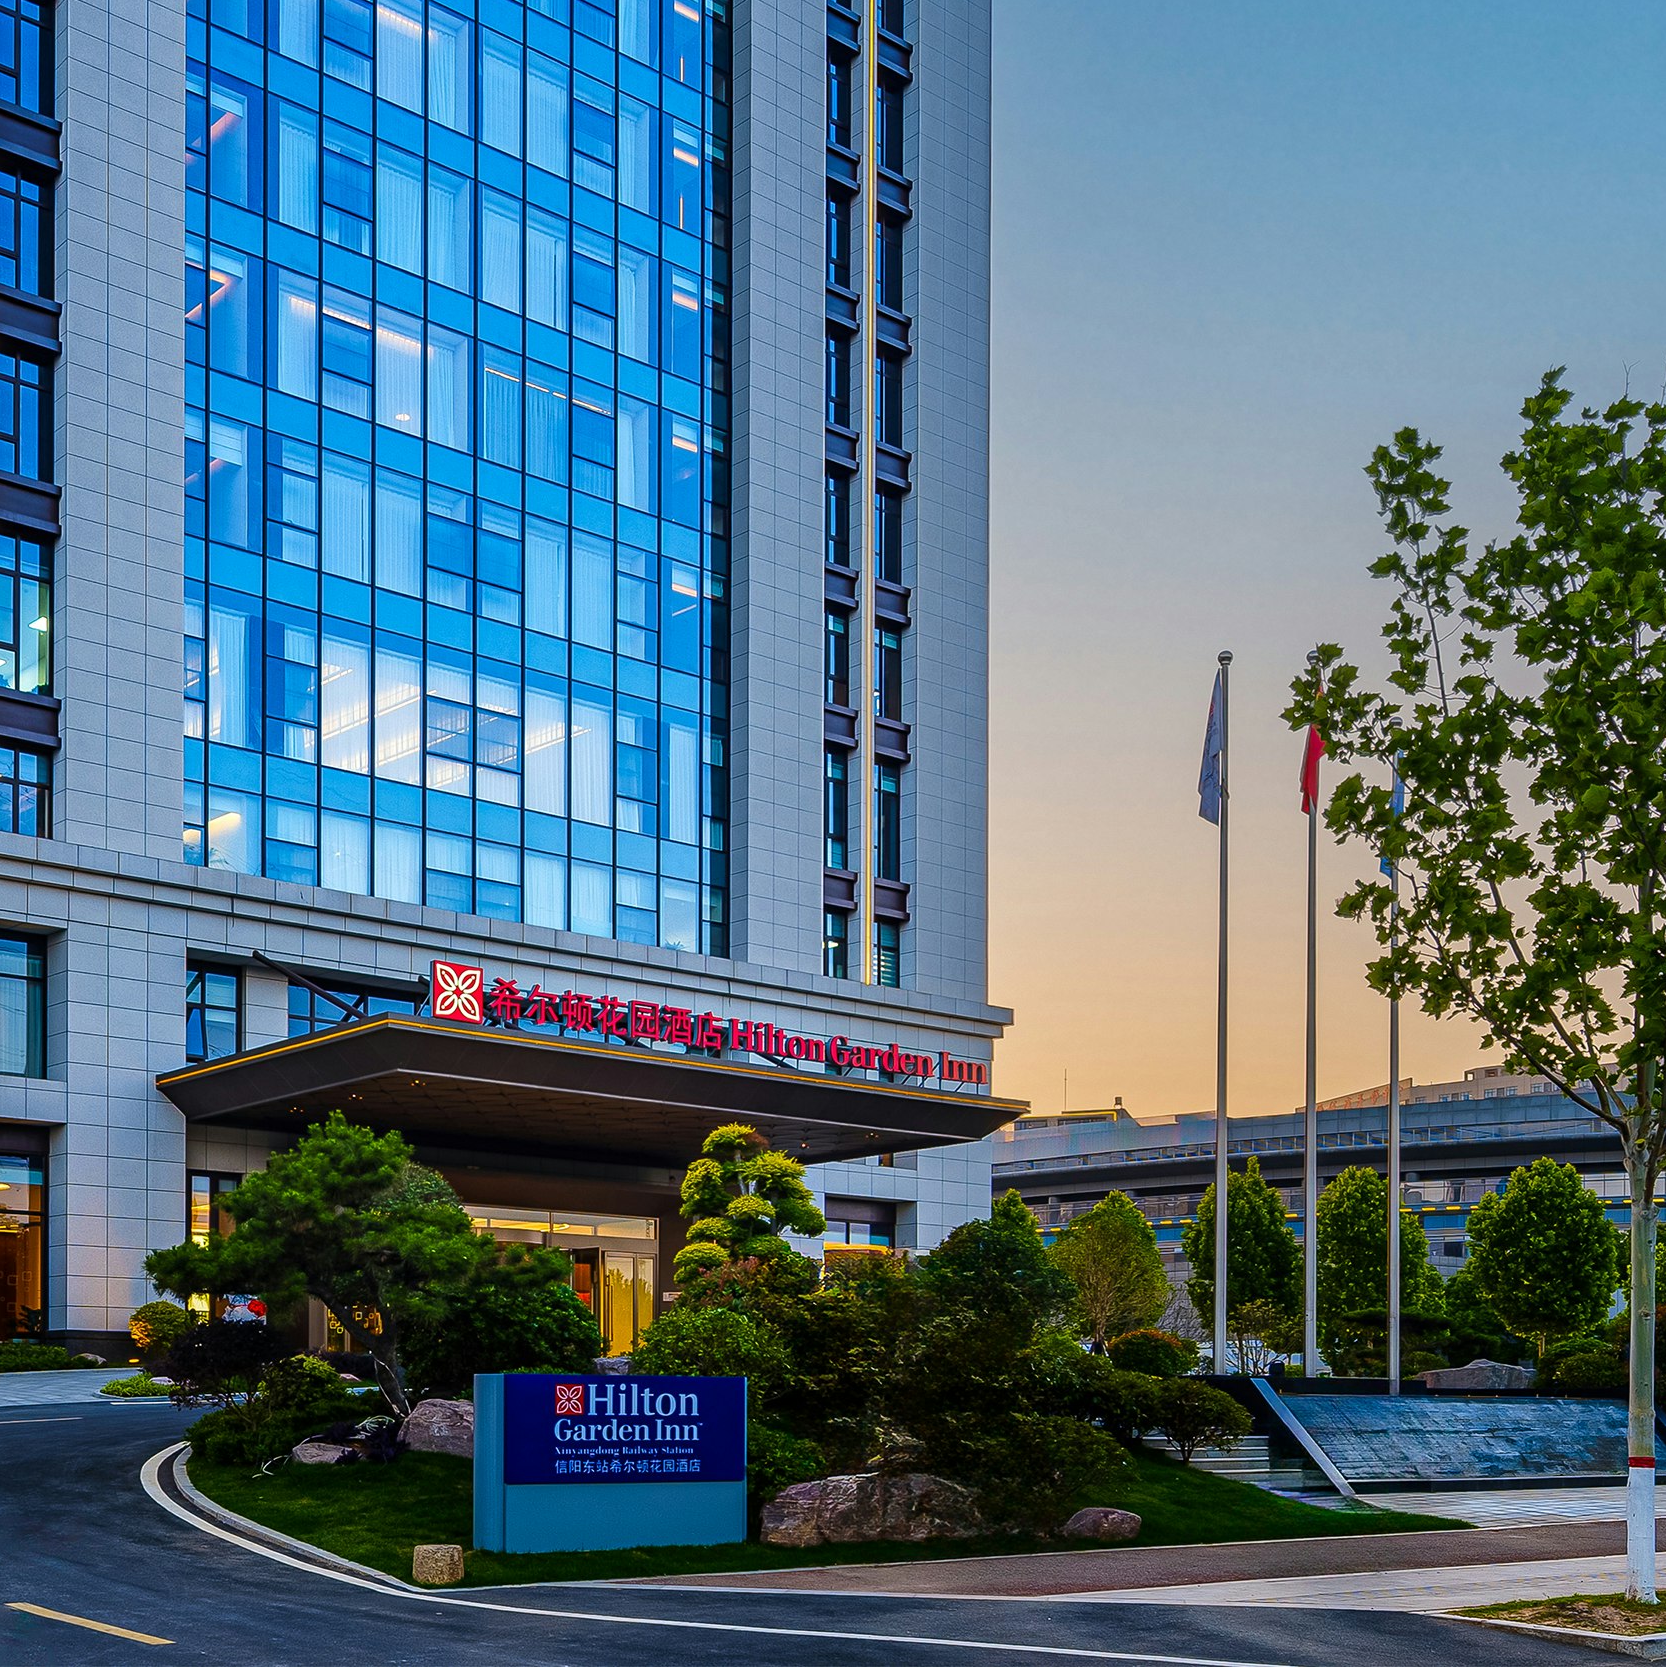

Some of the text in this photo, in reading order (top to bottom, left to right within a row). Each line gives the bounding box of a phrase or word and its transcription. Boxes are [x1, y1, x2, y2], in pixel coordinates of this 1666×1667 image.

[489, 977, 988, 1084] 希尔顿花园酒店 Hilton Garden Inn
[588, 1384, 699, 1416] Hilton
[554, 1419, 700, 1441] Garden Inn
[555, 1446, 694, 1457] Xinyangdong Railway Station
[555, 1459, 701, 1474] 信阳东站希尔顿花园酒店
